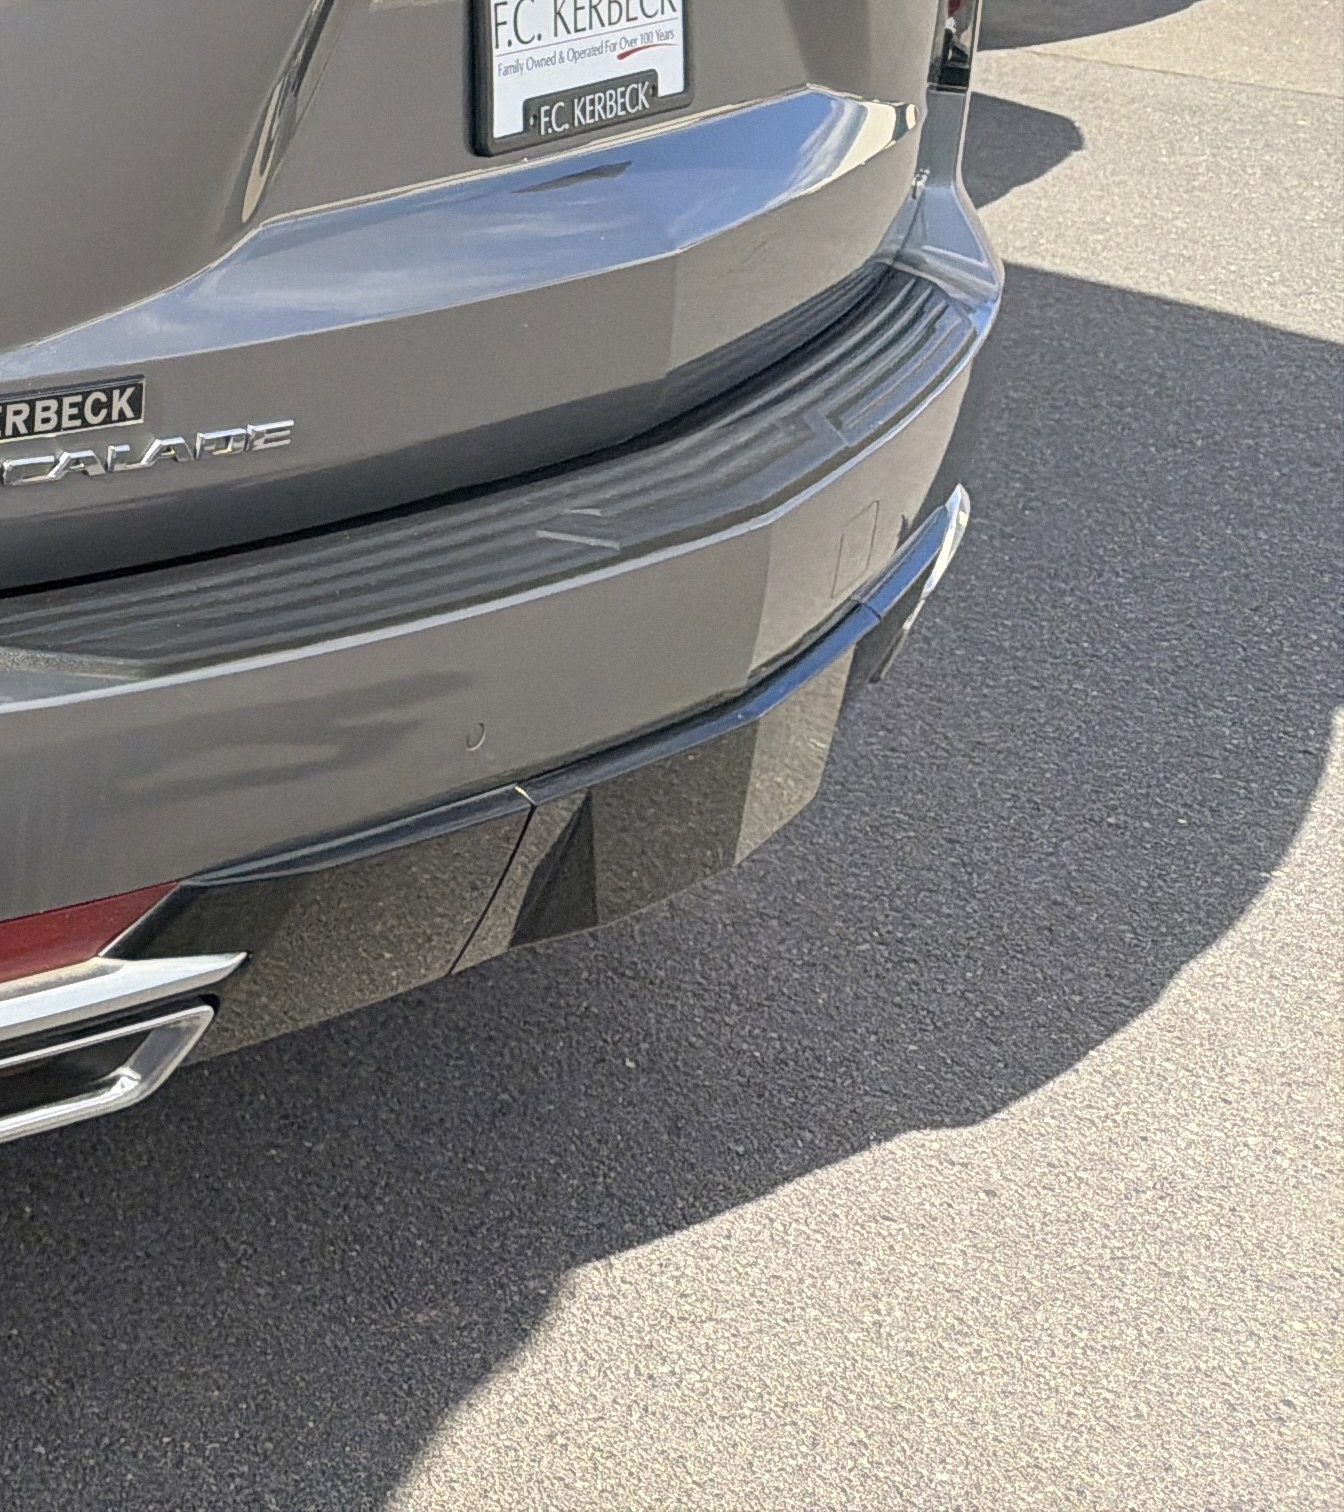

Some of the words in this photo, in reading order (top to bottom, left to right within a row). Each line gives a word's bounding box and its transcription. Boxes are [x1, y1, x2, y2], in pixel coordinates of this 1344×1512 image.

[498, 59, 524, 77] Family
[526, 52, 557, 70] Owned
[558, 51, 565, 64] &
[567, 46, 604, 66] Operated
[605, 40, 618, 54] For
[619, 36, 638, 50] Over
[640, 31, 654, 45] 100
[655, 28, 675, 42] Years
[540, 101, 570, 136] F.C.
[574, 81, 650, 127] KERBECK
